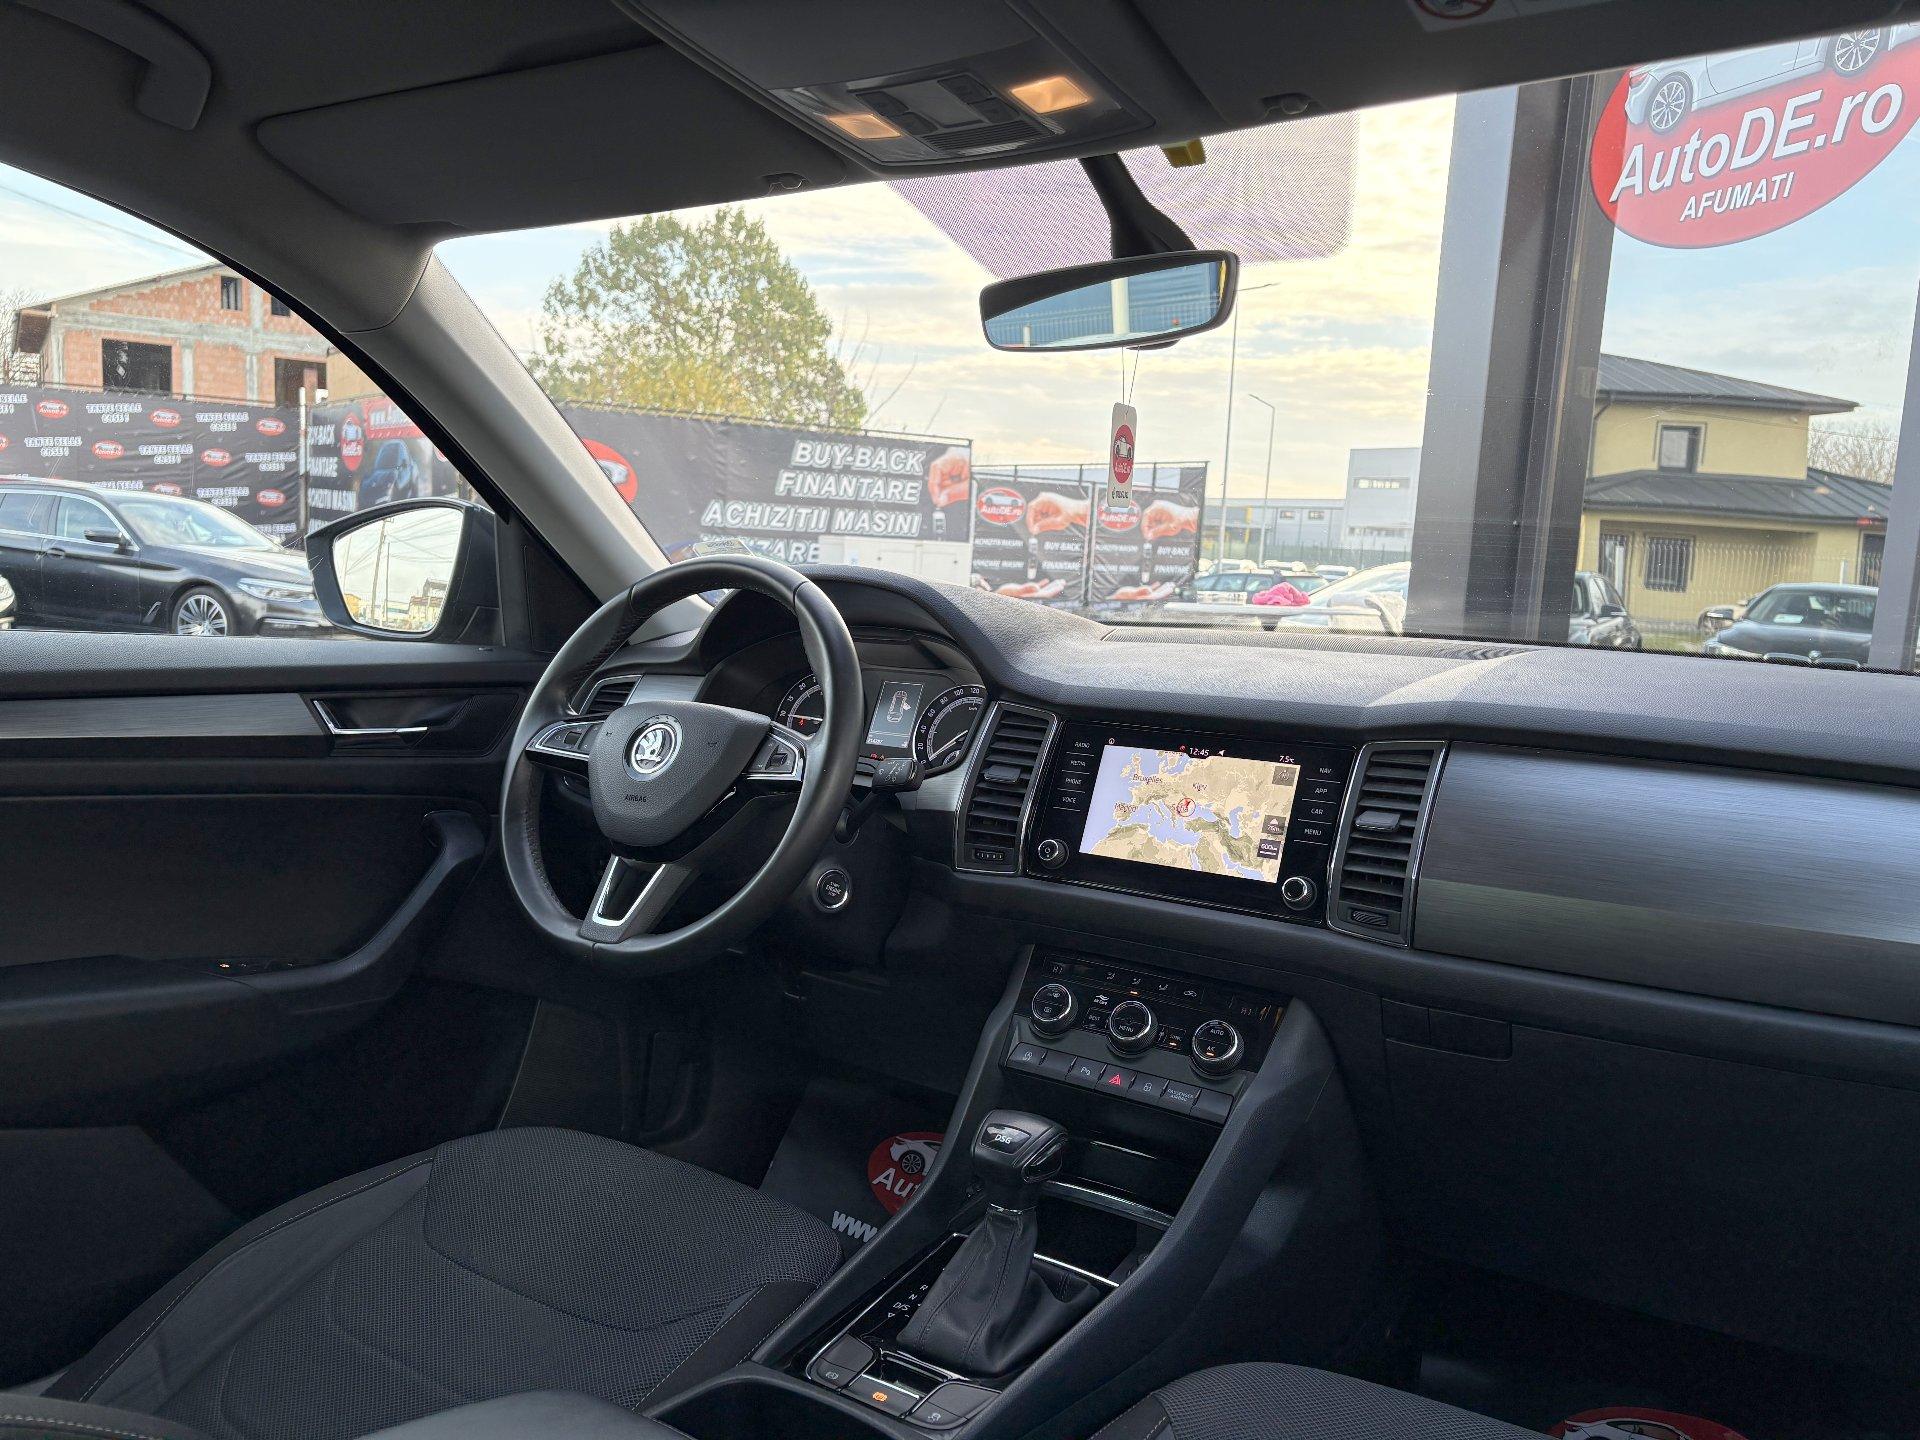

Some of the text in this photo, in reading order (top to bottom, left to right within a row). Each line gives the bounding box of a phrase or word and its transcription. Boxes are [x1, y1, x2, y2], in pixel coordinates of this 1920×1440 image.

[1609, 83, 1903, 203] AutoDE.ro
[1680, 171, 1795, 222] AFUMATI
[790, 440, 928, 477] BUY-BACK
[775, 470, 923, 504] FINANTARE
[701, 501, 922, 537] ACHIZITII MASINI
[1189, 747, 1210, 757] 12:45
[624, 794, 647, 803] AIRBAG
[1304, 828, 1322, 836] MENU
[1118, 1024, 1134, 1033] MENU
[1210, 1028, 1225, 1036] AUTO
[994, 1133, 1011, 1144] DSG
